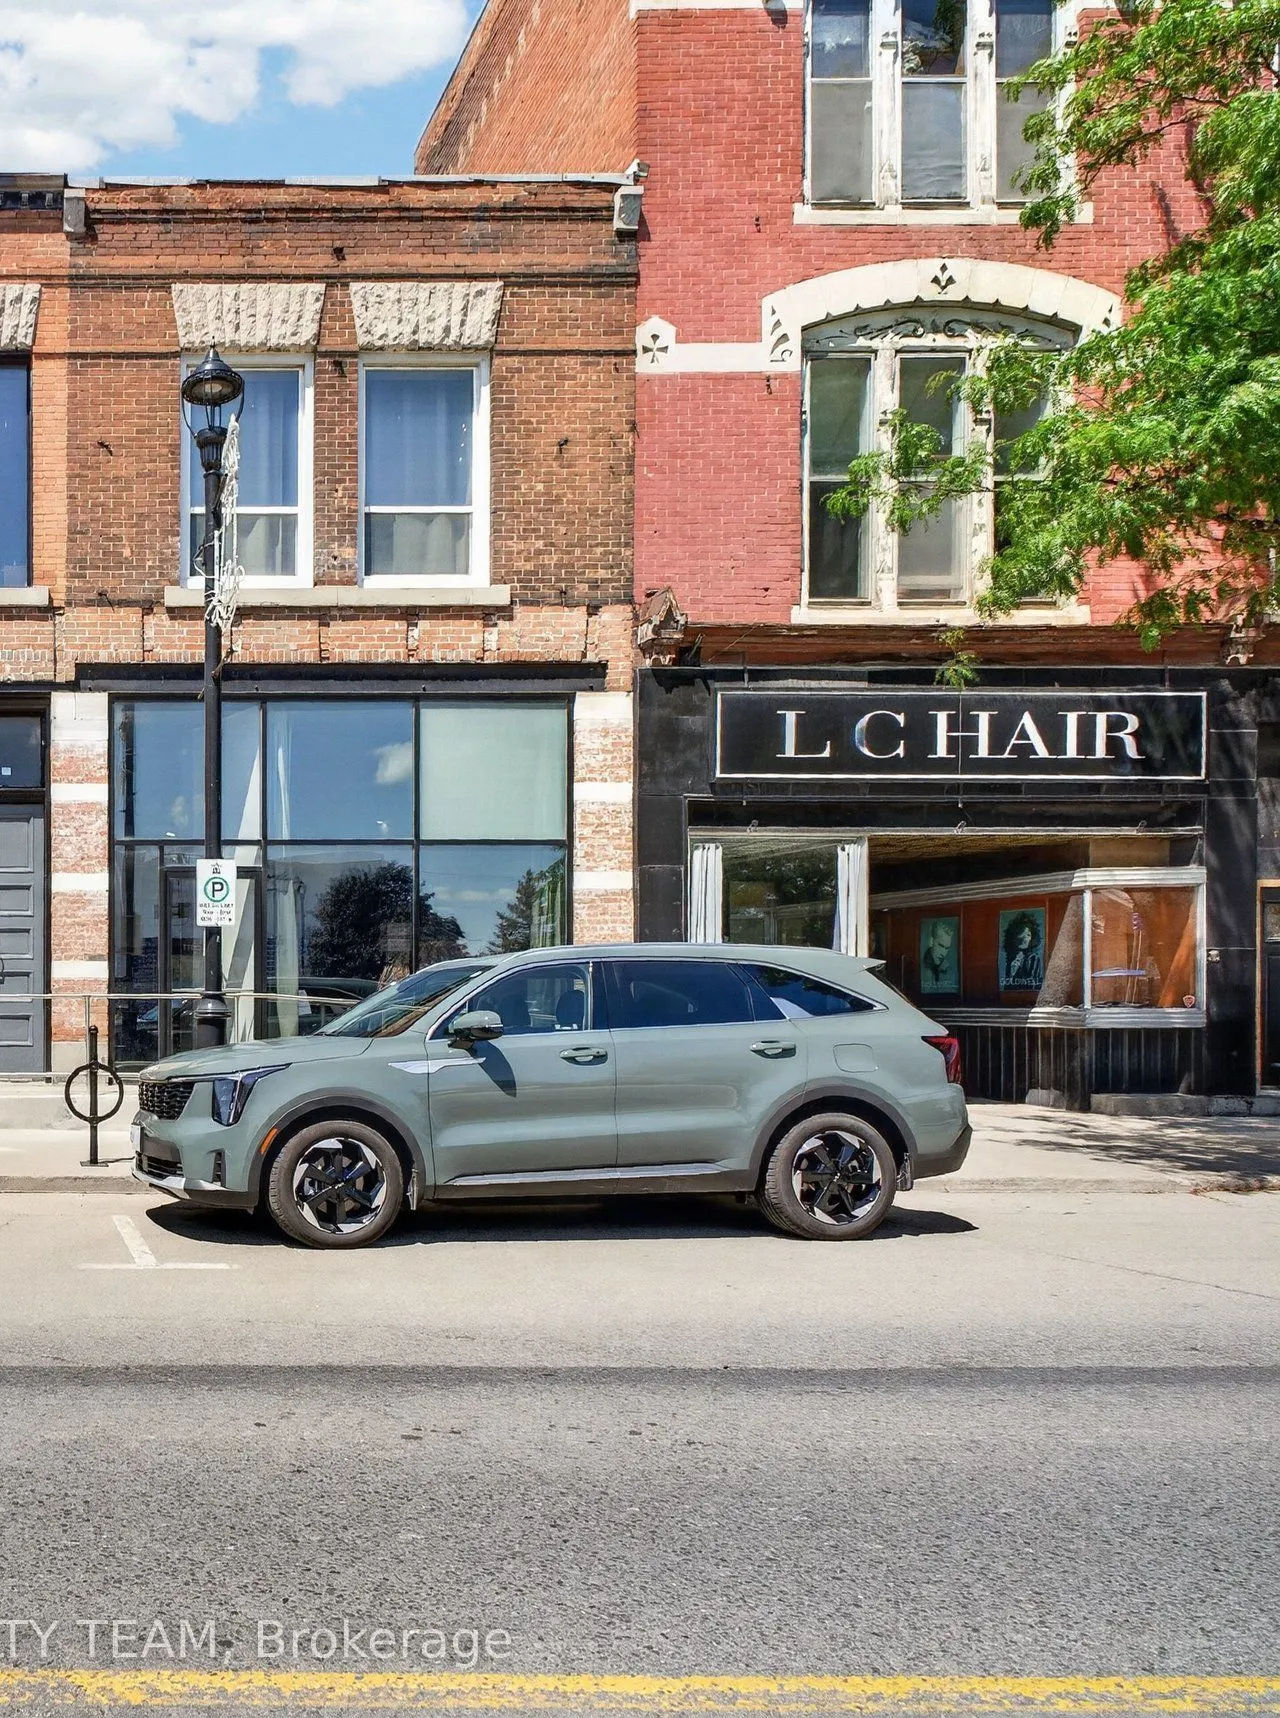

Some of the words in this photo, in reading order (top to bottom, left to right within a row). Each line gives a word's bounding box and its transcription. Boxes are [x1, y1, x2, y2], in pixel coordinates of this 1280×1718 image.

[775, 709, 831, 759] L
[853, 709, 905, 760] C
[926, 709, 1147, 760] HAIR
[211, 881, 225, 898] P
